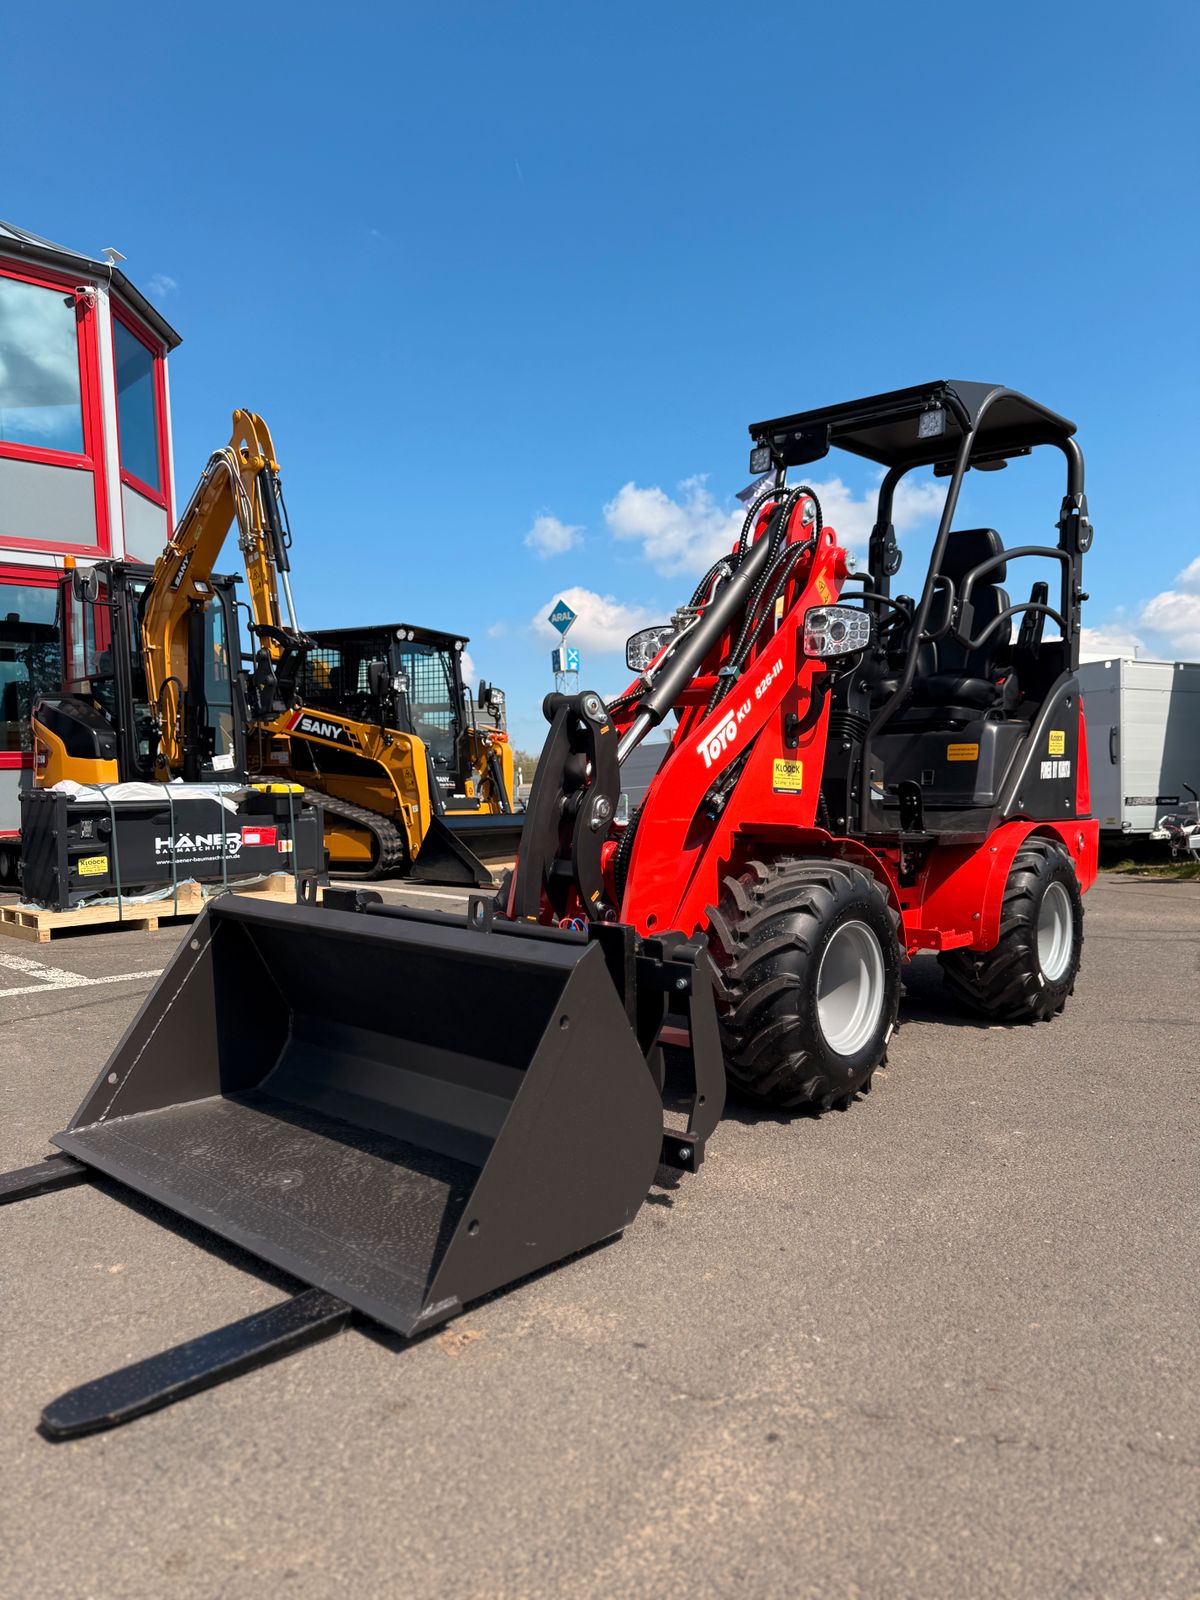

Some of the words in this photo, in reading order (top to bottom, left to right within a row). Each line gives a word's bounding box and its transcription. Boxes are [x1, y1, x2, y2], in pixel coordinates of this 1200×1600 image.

[551, 611, 573, 623] ARAL
[754, 657, 784, 700] 826-III
[300, 718, 343, 740] SANY
[155, 832, 242, 854] HÄNER
